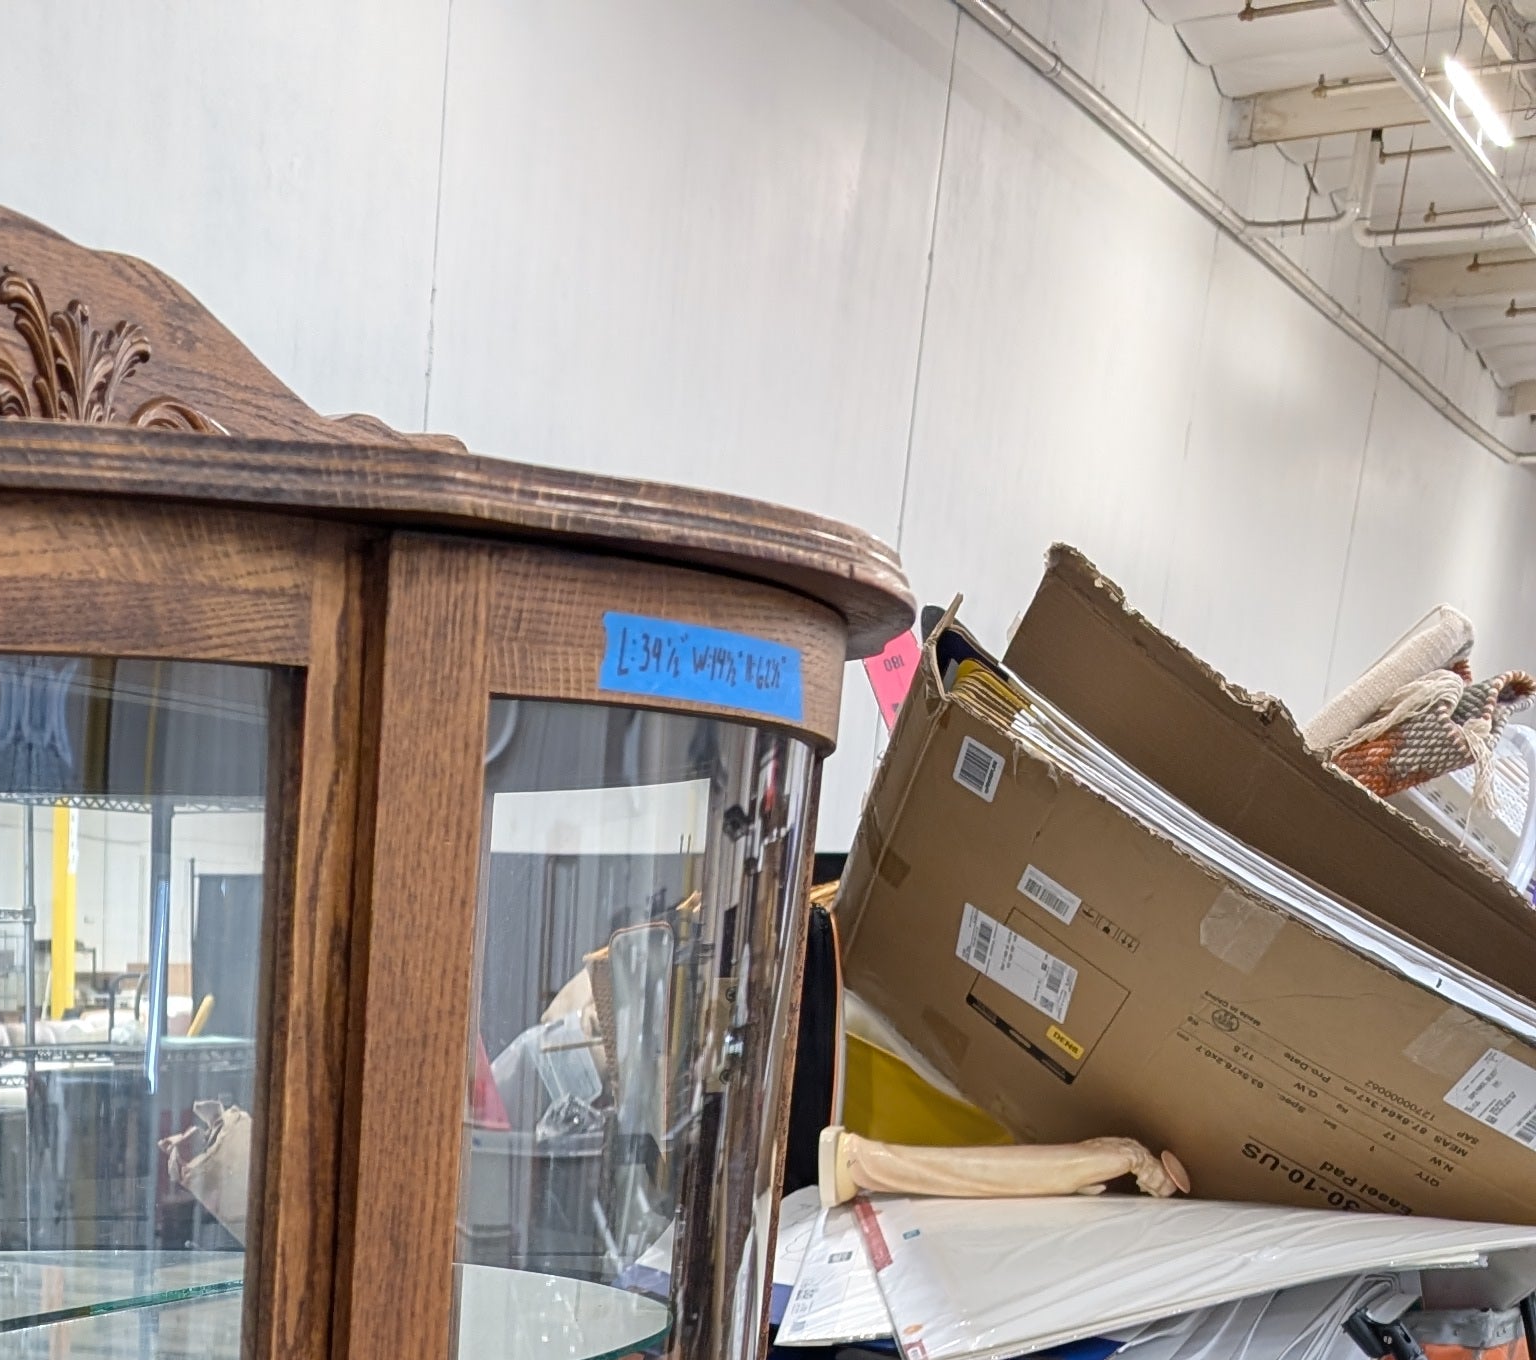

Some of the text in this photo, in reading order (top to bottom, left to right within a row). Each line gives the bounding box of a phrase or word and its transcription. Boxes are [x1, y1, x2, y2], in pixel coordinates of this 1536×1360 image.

[1382, 1131, 1396, 1142] 17
[1456, 1131, 1480, 1145] SAP
[1433, 1135, 1469, 1157] MEAS
[1415, 1170, 1440, 1188] QTY
[1319, 1160, 1413, 1217] Easel Pad
